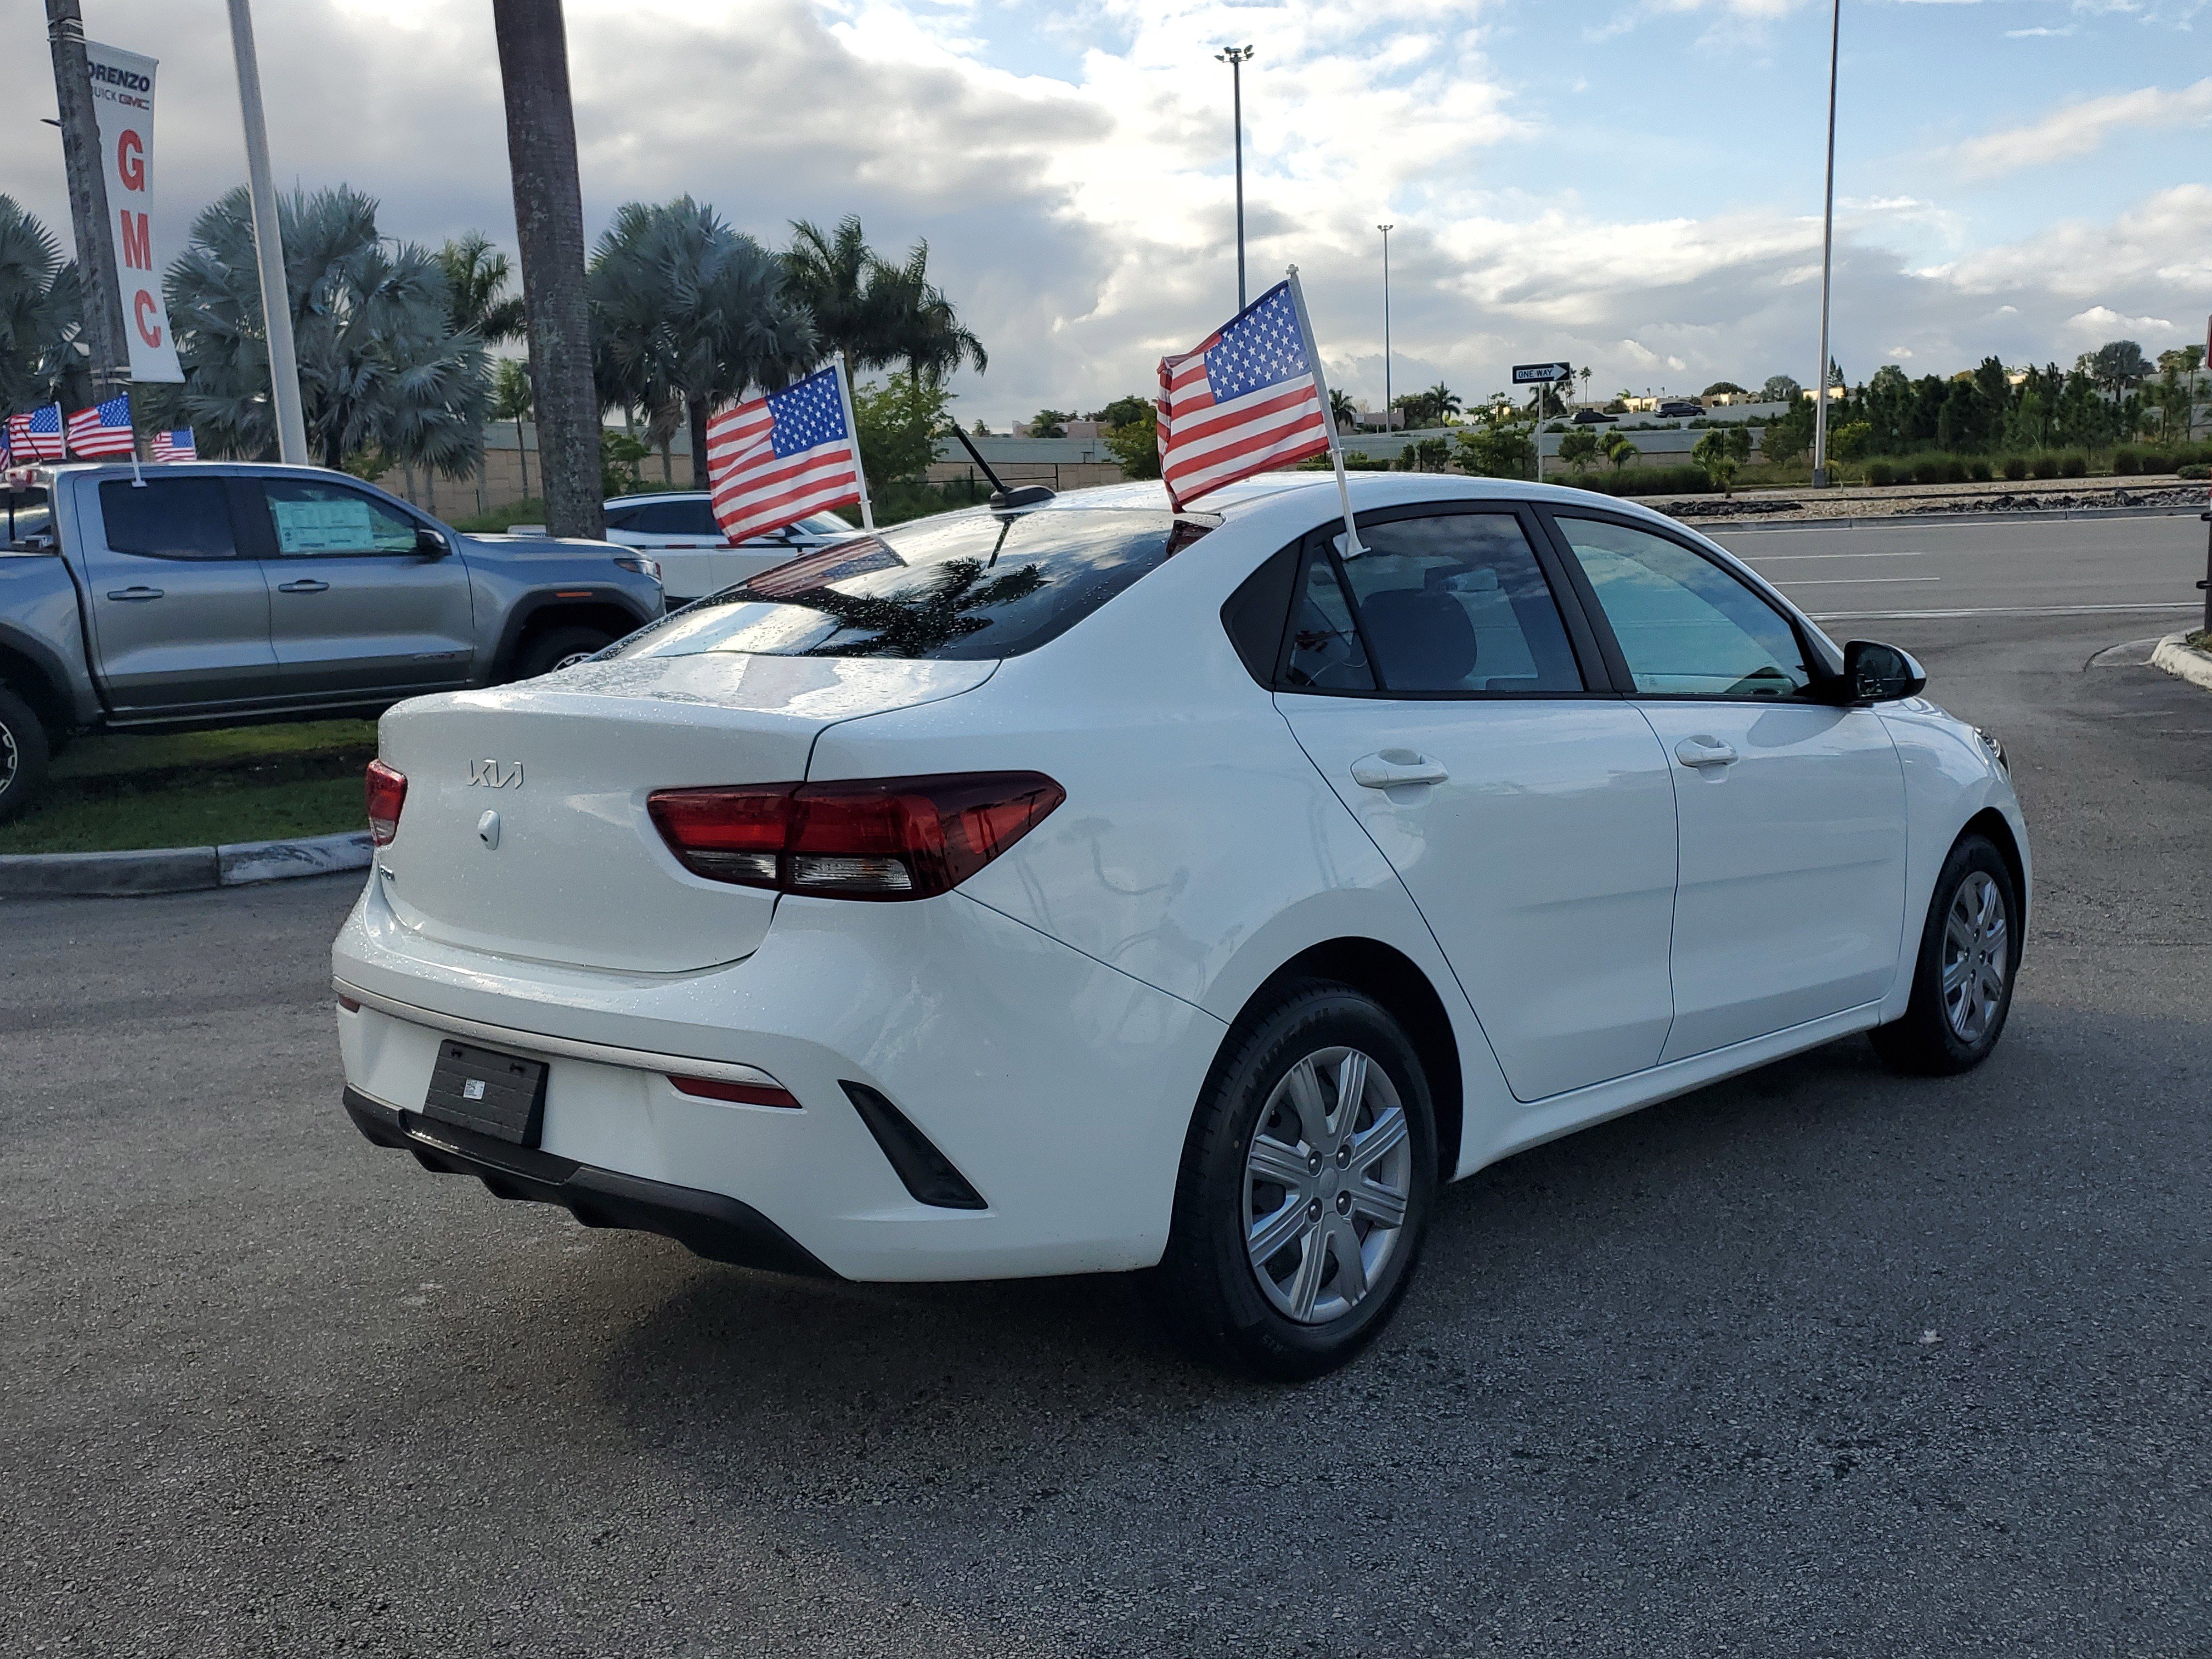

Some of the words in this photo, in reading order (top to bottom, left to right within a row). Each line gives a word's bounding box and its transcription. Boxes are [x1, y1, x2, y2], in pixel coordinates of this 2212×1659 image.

[88, 61, 150, 92] ORENZO
[93, 87, 117, 102] UICK
[119, 93, 150, 110] GMC
[117, 128, 161, 348] GMC
[1518, 370, 1534, 379] ONE
[1535, 368, 1553, 377] WAY
[466, 759, 524, 790] KIA
